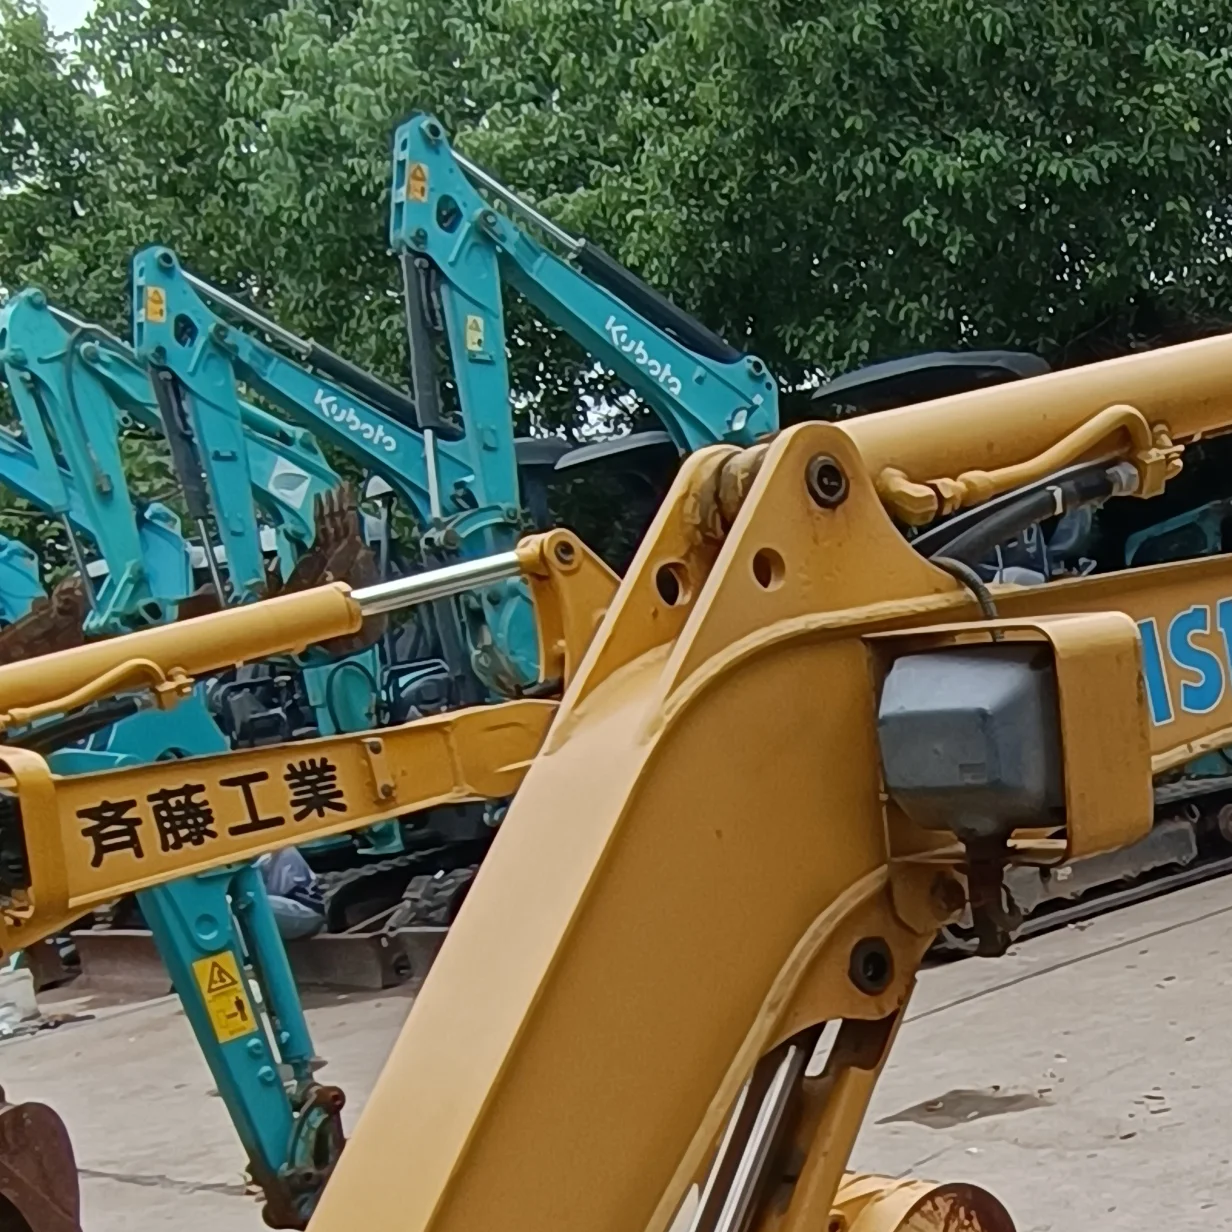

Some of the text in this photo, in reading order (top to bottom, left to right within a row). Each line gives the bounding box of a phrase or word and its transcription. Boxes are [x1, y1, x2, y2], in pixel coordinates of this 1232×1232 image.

[605, 315, 682, 396] Kubota
[314, 388, 397, 452] Kubota
[75, 757, 348, 868] 斉藤工業
